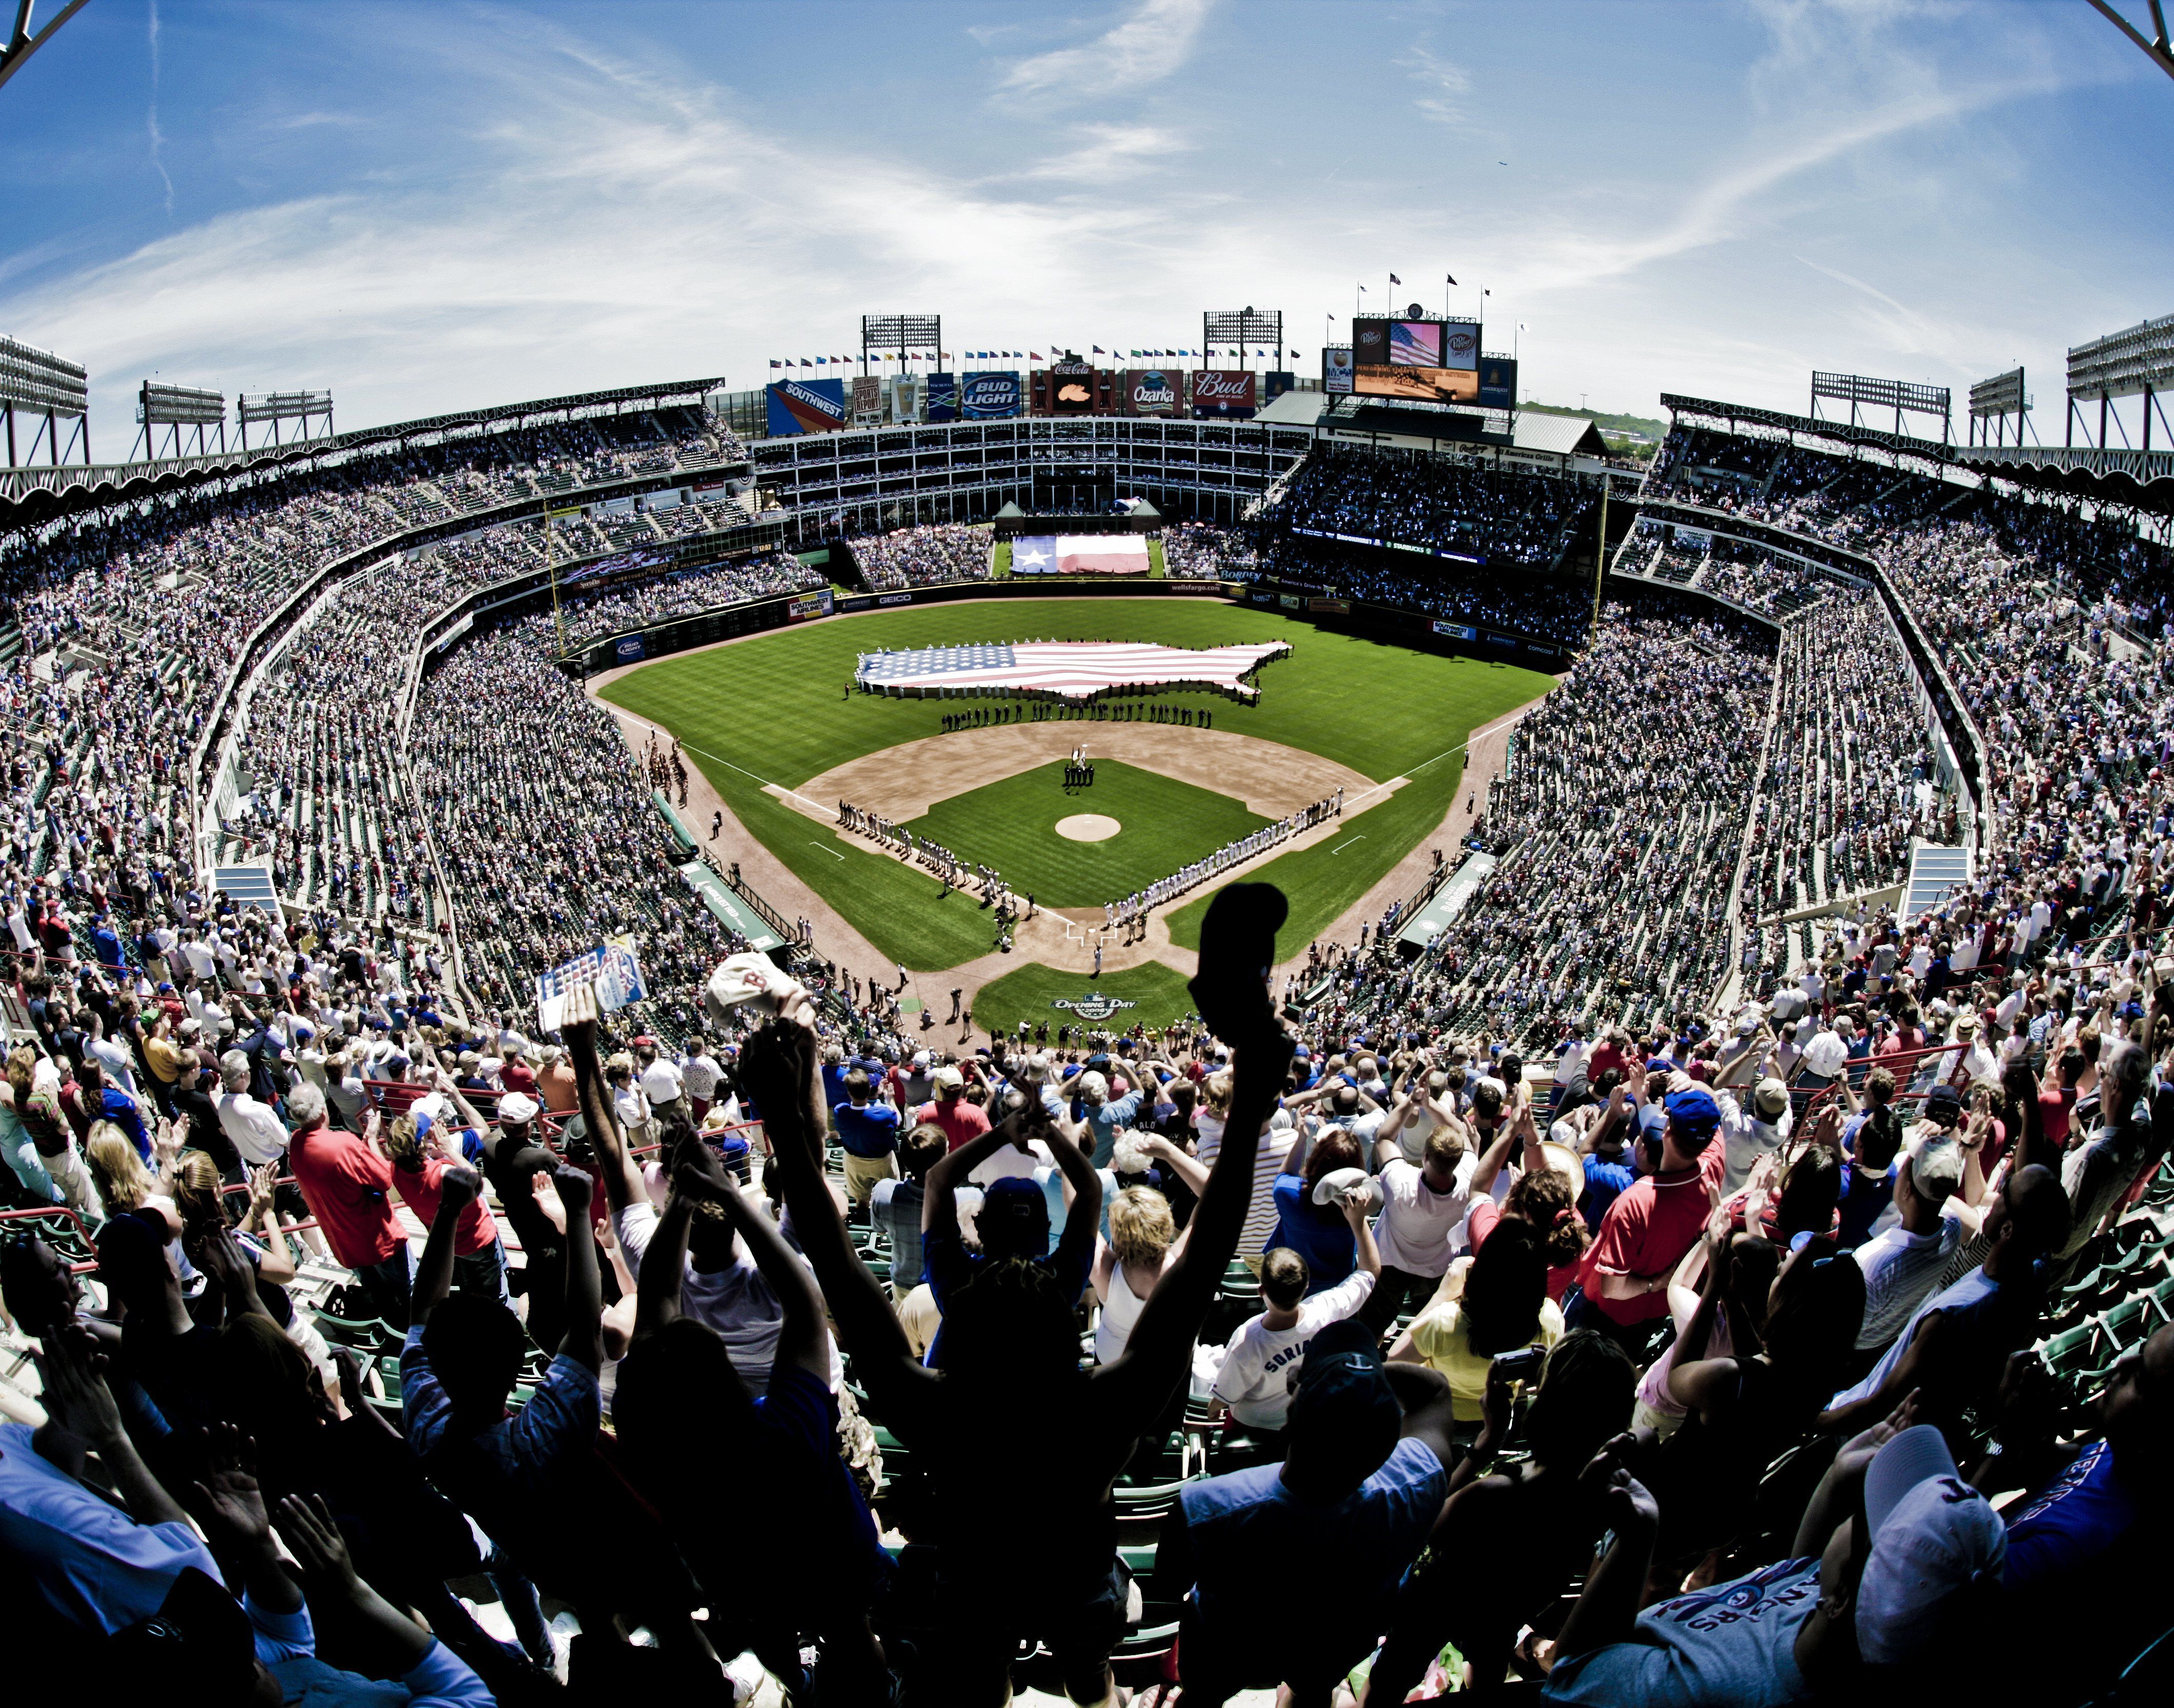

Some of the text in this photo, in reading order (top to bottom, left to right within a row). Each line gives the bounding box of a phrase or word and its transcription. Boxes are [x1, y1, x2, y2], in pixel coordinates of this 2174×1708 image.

[1363, 333, 1380, 343] Pepper
[1451, 339, 1470, 348] Pepper
[976, 382, 1013, 393] BUD
[1196, 372, 1250, 396] Bud
[855, 387, 878, 401] SPORTS
[1134, 386, 1174, 403] Ozarka
[786, 383, 842, 417] SOUTHWEST
[856, 398, 878, 411] REPORT
[966, 394, 1017, 405] LIGHT
[1505, 450, 1534, 459] American
[1535, 454, 1554, 462] Grille
[1393, 543, 1424, 553] STARBUCKS
[614, 572, 647, 582] AMERIQUEST
[1220, 570, 1263, 580] BORDEN
[579, 579, 600, 589] SportsDay
[1281, 578, 1303, 587] America's
[791, 597, 828, 610] SOUTHWEST
[879, 595, 911, 604] GEICO
[797, 604, 824, 614] AIRLINES
[1435, 622, 1467, 633] SOUTHWEST
[1439, 627, 1462, 636] AIRLINES
[622, 645, 641, 653] LIGHT
[1528, 646, 1554, 654] comcast
[704, 885, 726, 909] AMERIQUEST
[725, 905, 739, 918] FIELD
[1441, 880, 1477, 914] RANGERS
[743, 972, 767, 993] B
[1055, 999, 1135, 1008] OPENING DAY
